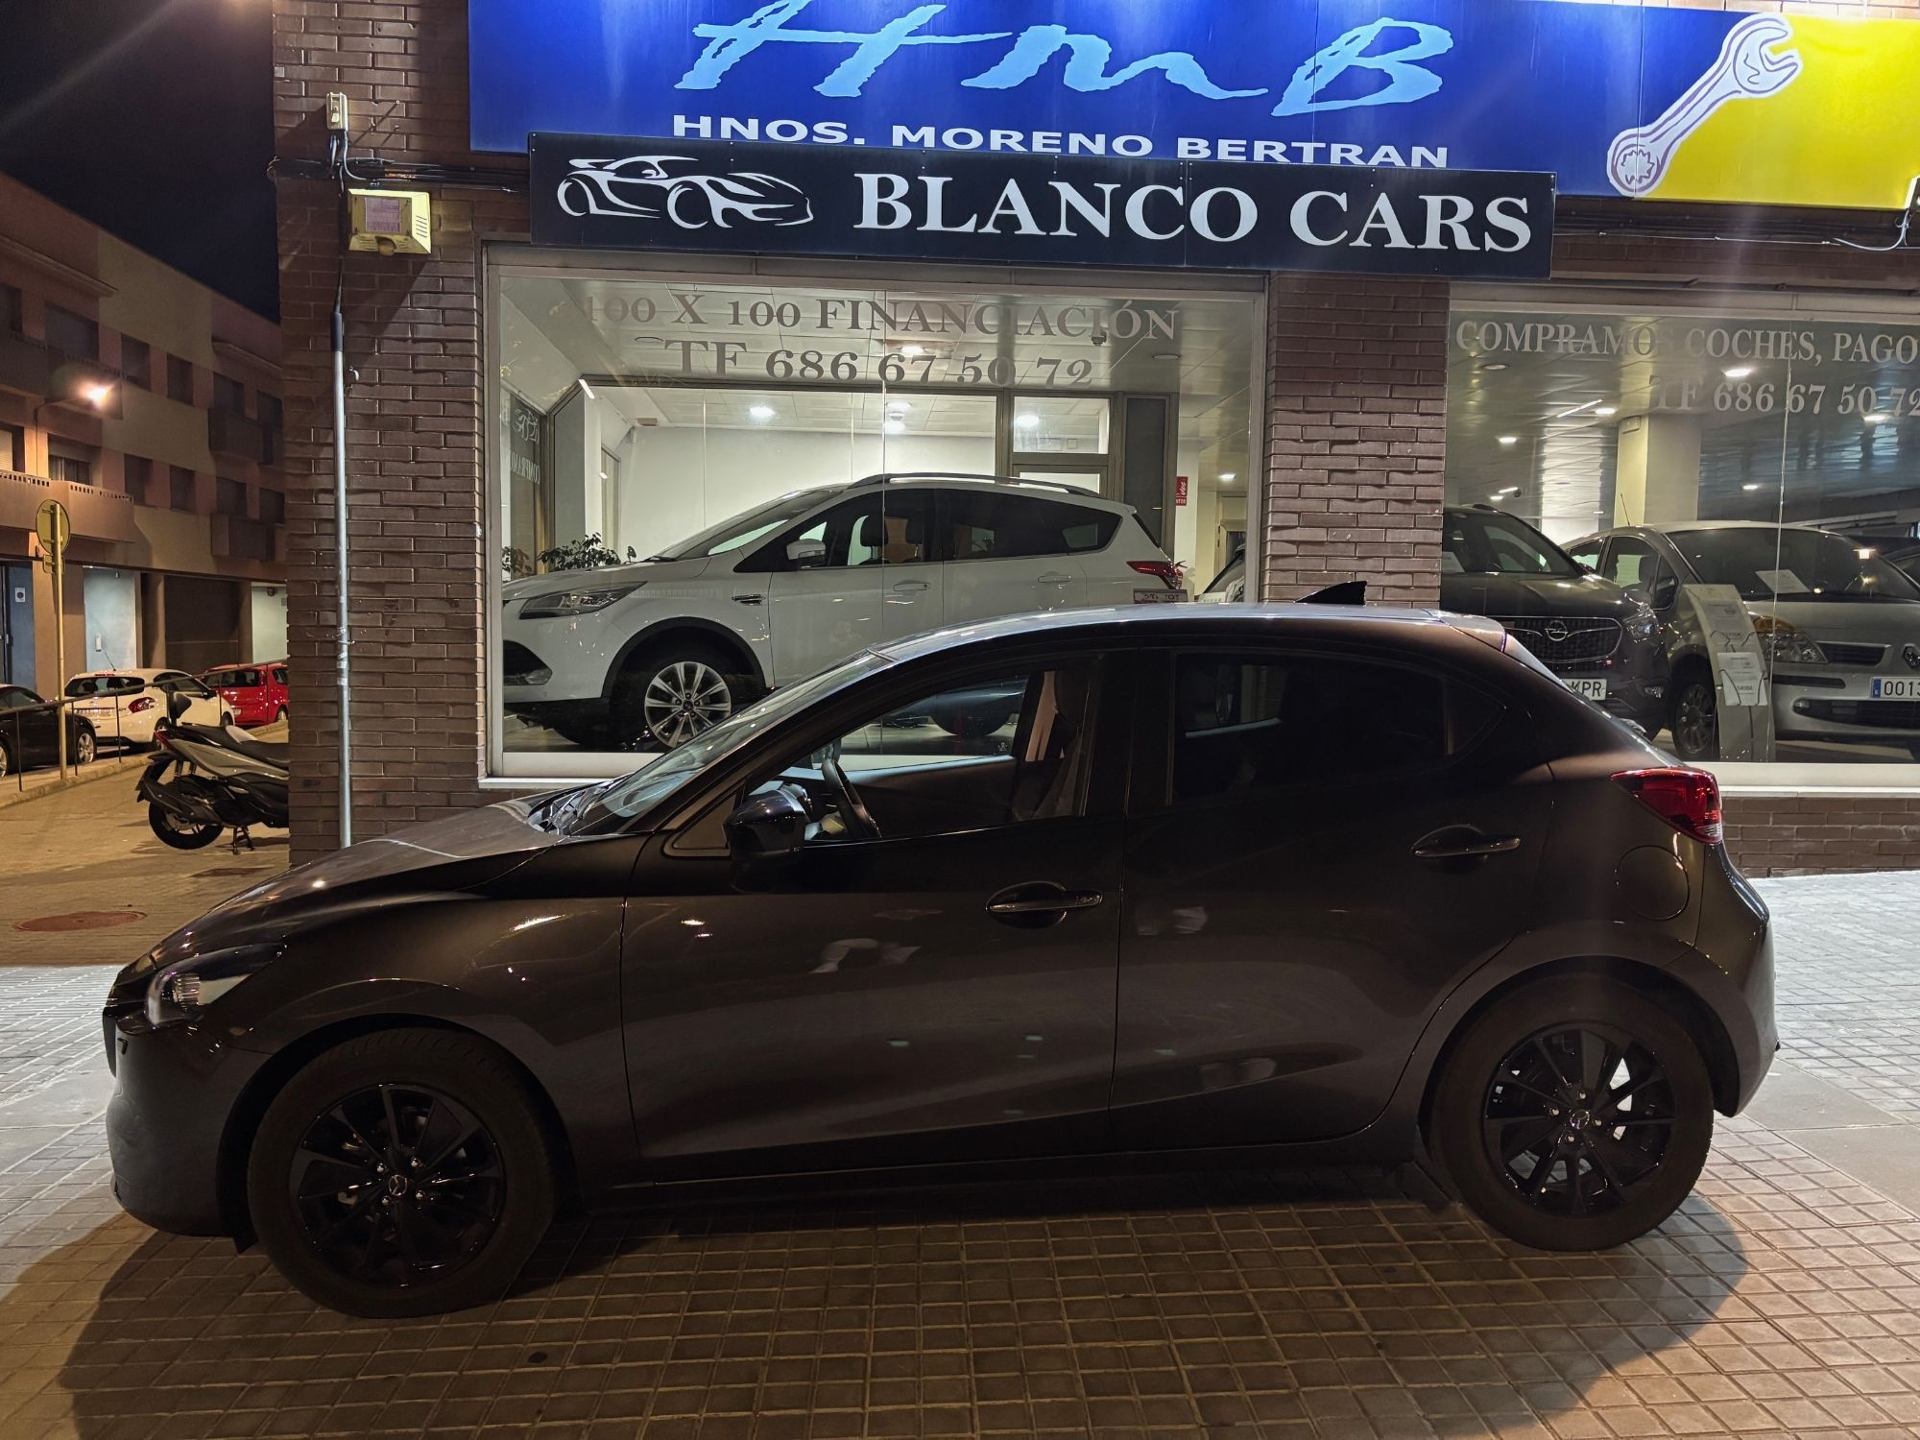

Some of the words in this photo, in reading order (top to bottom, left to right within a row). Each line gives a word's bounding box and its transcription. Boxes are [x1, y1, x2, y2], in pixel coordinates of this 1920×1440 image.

[673, 114, 865, 145] HNOS.
[892, 125, 1154, 157] MORENO
[1177, 137, 1449, 167] BERTRAN
[854, 172, 1259, 243] BLANCO
[1290, 190, 1532, 253] CARS
[671, 294, 708, 325] X
[727, 300, 801, 328] 100
[815, 299, 1180, 340] FINANCIACIÓN
[664, 339, 747, 377] TF
[766, 349, 858, 381] 686
[878, 352, 937, 384] 67
[956, 353, 1017, 388] 50
[1036, 357, 1093, 389] 72
[1685, 328, 1821, 366] COCHES,
[1713, 382, 1775, 412] 686
[1788, 384, 1826, 414] 67
[1837, 384, 1877, 415] 50
